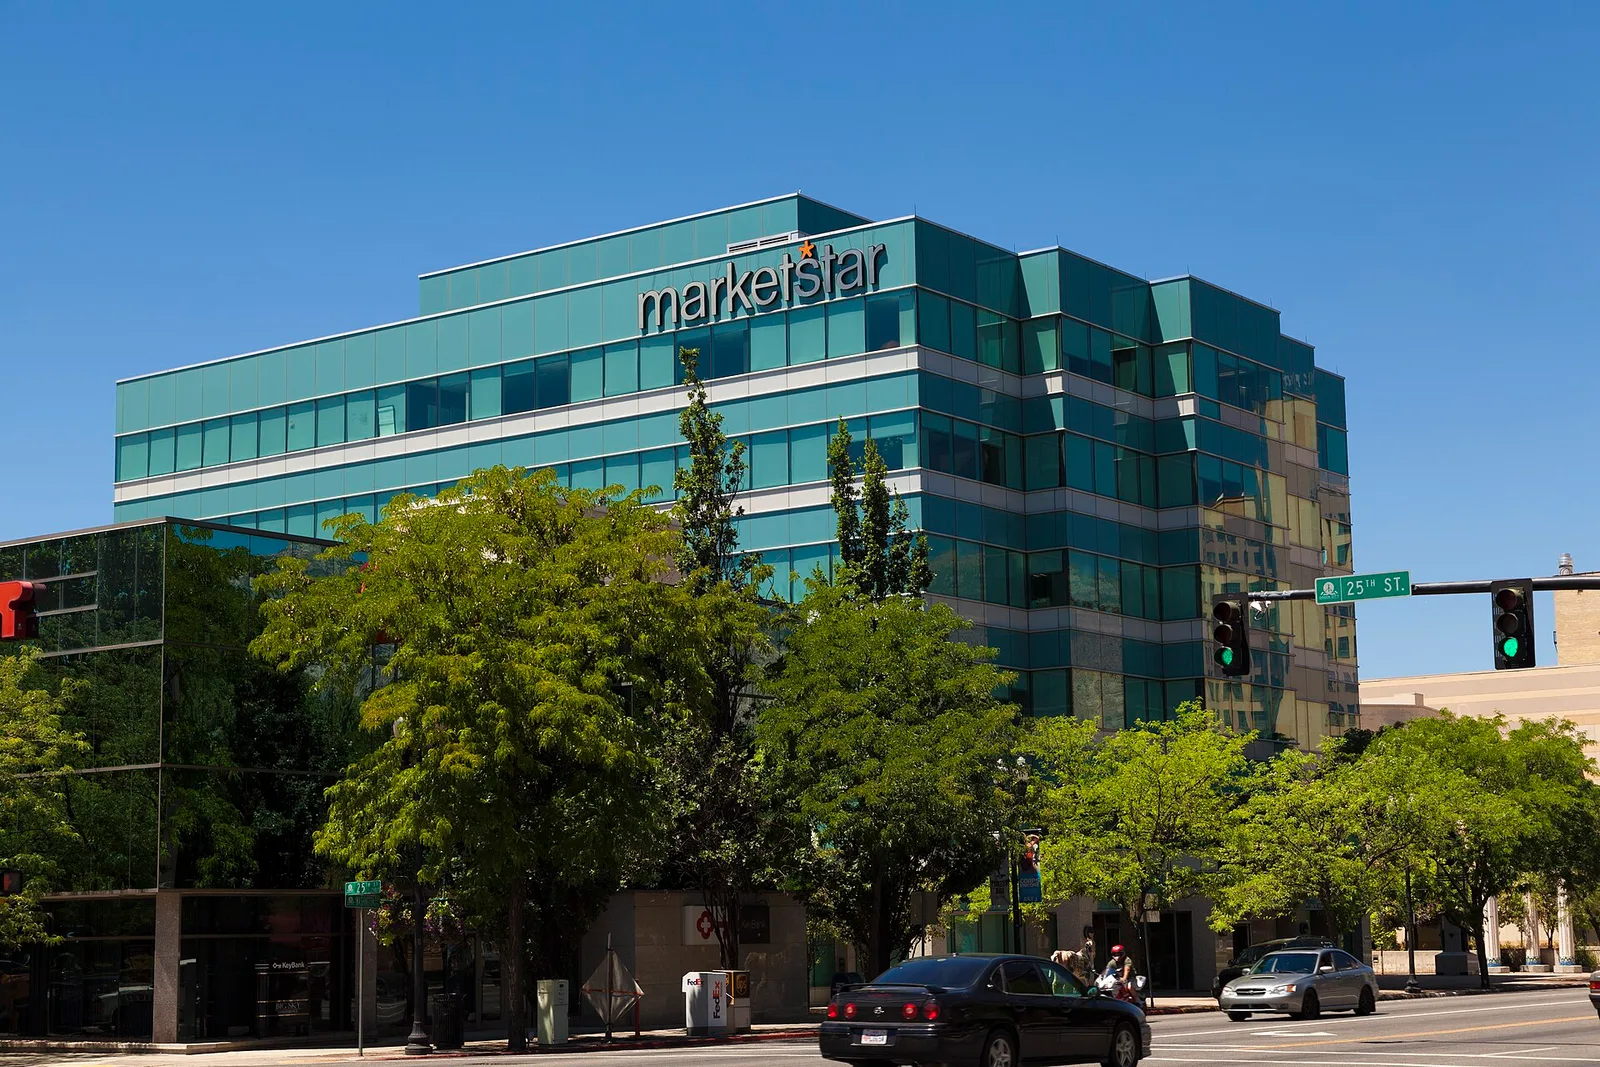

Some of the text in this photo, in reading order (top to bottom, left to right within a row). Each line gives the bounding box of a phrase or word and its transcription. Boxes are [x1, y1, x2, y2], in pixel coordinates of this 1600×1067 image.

[637, 243, 885, 330] marketstar
[1346, 576, 1405, 596] 25TH ST.
[281, 961, 305, 970] KeyBank
[712, 981, 721, 1019] FedEx
